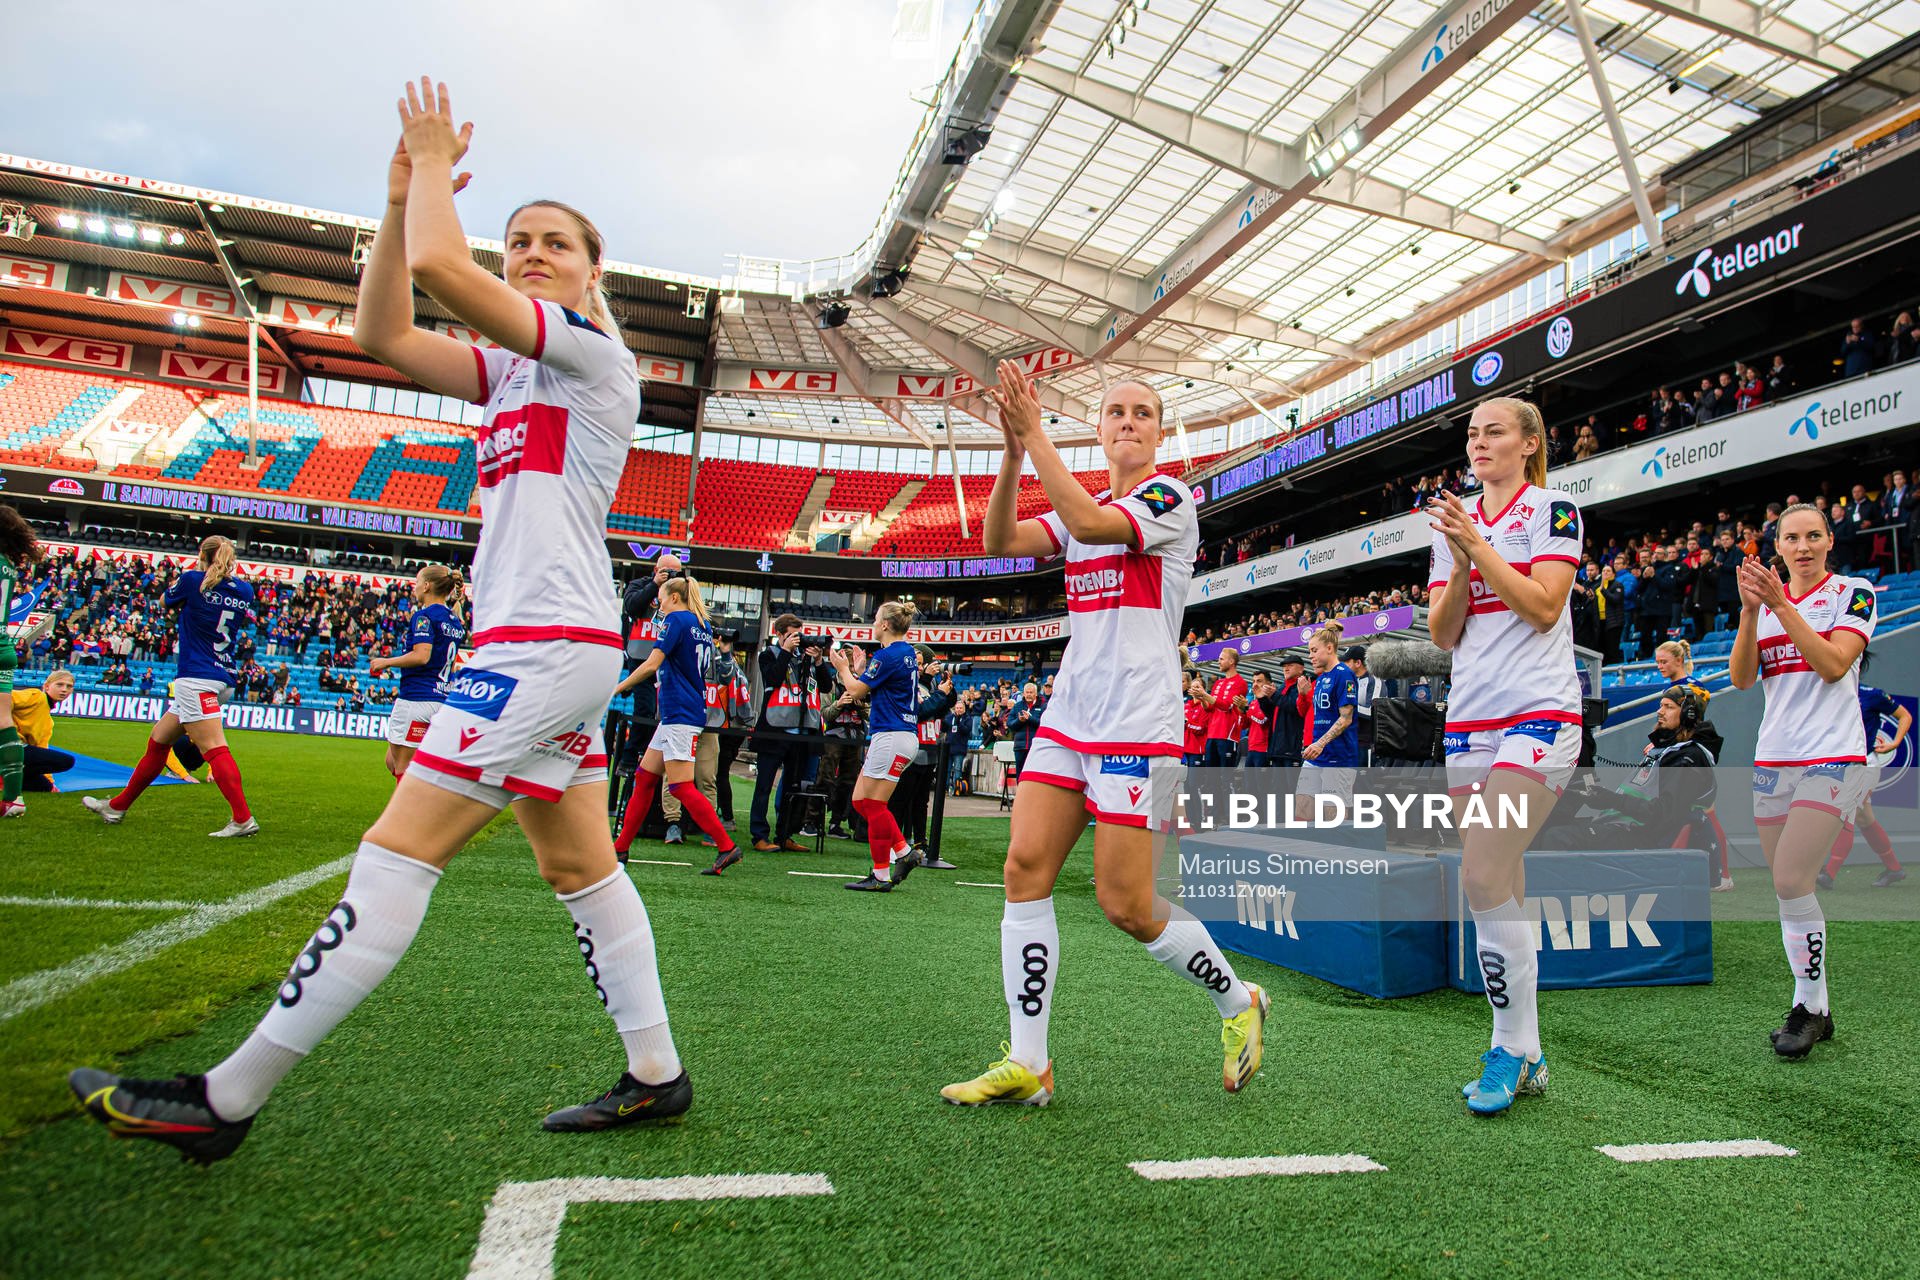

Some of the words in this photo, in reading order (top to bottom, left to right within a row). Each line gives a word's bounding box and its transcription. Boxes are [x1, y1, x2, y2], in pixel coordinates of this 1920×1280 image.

[1448, 0, 1510, 51] teleno
[1254, 187, 1282, 218] telen
[1711, 222, 1804, 282] telenor
[1165, 258, 1194, 292] telenor
[124, 277, 231, 313] VG
[11, 332, 119, 366] VG
[173, 355, 273, 388] VG
[753, 370, 833, 392] VG
[1401, 369, 1456, 422] FOTBALL
[1820, 390, 1903, 429] telenor
[1666, 440, 1728, 470] telenor
[1551, 477, 1593, 496] lenor
[102, 483, 117, 500] IL
[120, 485, 208, 511] SANDVIKEN
[211, 497, 309, 523] TOPPFOTBALL
[405, 517, 464, 541] FOTBALL
[1373, 529, 1405, 548] telenor
[241, 563, 292, 580] VG
[881, 560, 946, 578] VELKOMMEN
[948, 560, 961, 577] TIL
[963, 557, 1015, 577] CUPFINALEN
[1015, 556, 1035, 572] 2021
[1256, 563, 1278, 580] telenor
[1309, 547, 1336, 566] telenor
[1209, 577, 1229, 592] telenor
[213, 610, 234, 652] 5
[828, 627, 872, 641] VG
[926, 629, 964, 642] VG
[970, 629, 1001, 642] VG
[1006, 627, 1036, 641] VG
[1038, 623, 1059, 639] VG
[314, 709, 391, 739] VÅLEREN
[1807, 931, 1823, 981] coop
[1018, 943, 1049, 1016] coop
[1187, 950, 1231, 994] coop
[1479, 950, 1510, 1009] coop
